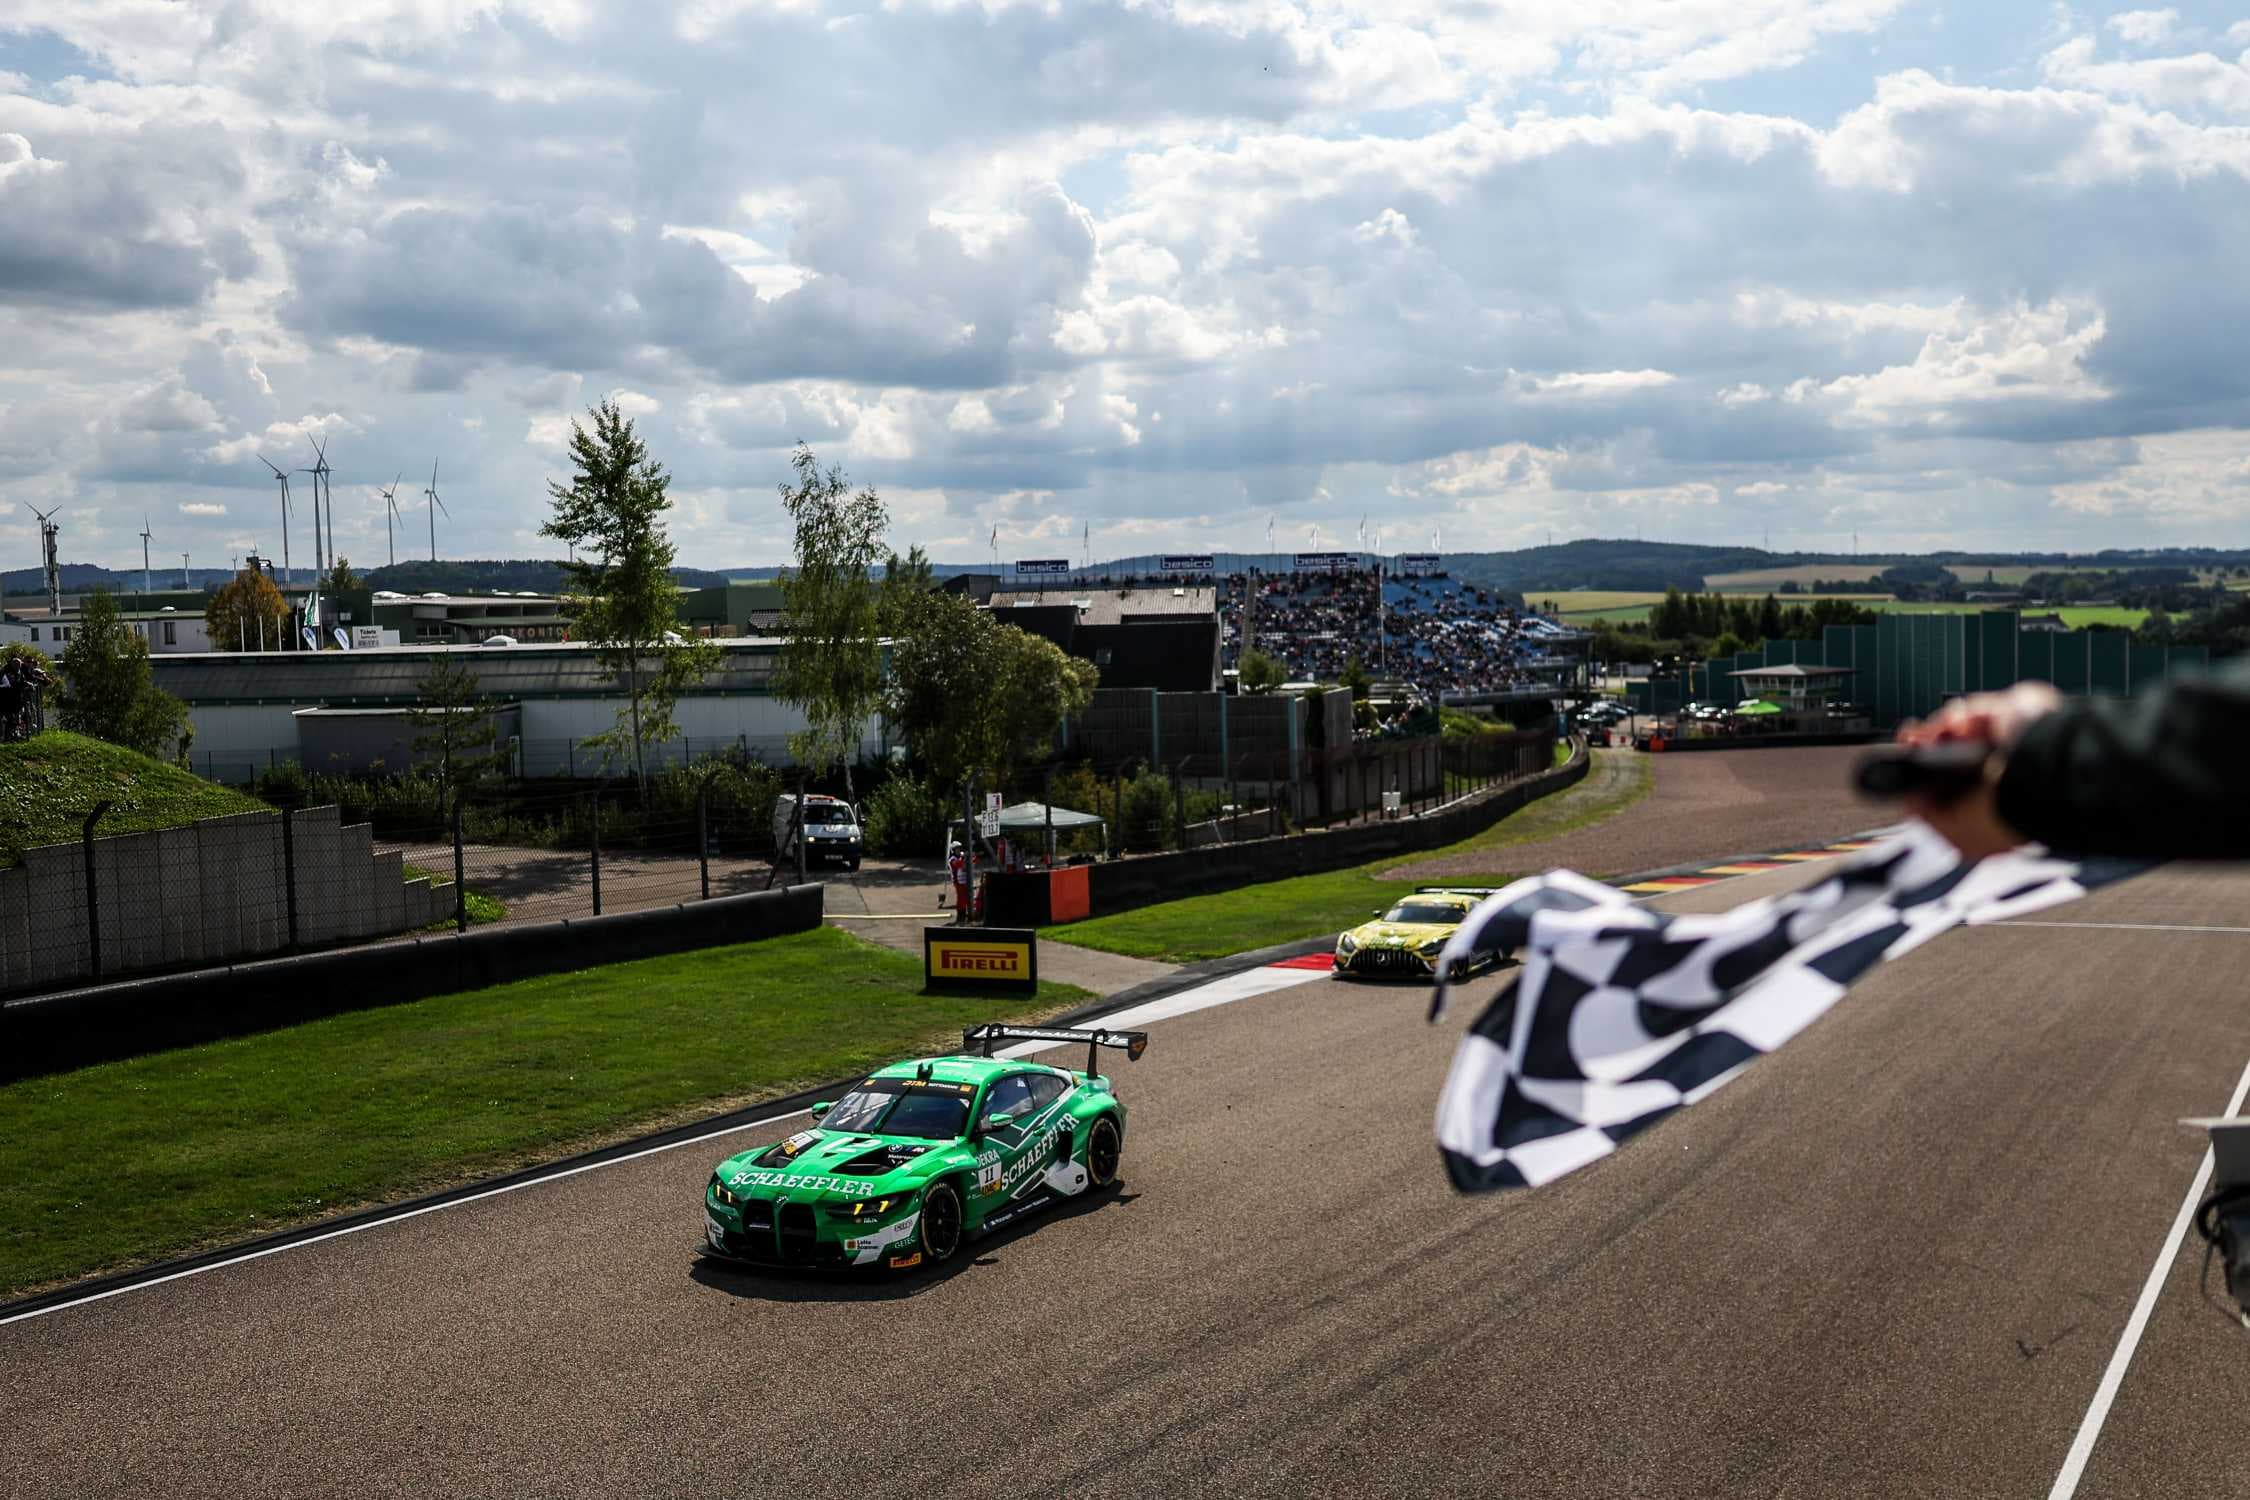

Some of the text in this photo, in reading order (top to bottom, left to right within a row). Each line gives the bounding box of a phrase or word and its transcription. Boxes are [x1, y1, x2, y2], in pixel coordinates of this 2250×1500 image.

[1018, 561, 1068, 572] besico
[1162, 557, 1213, 569] besico
[941, 950, 1018, 971] PIRELLI
[728, 1171, 875, 1197] SCHAEFFLER
[984, 1166, 994, 1184] 11
